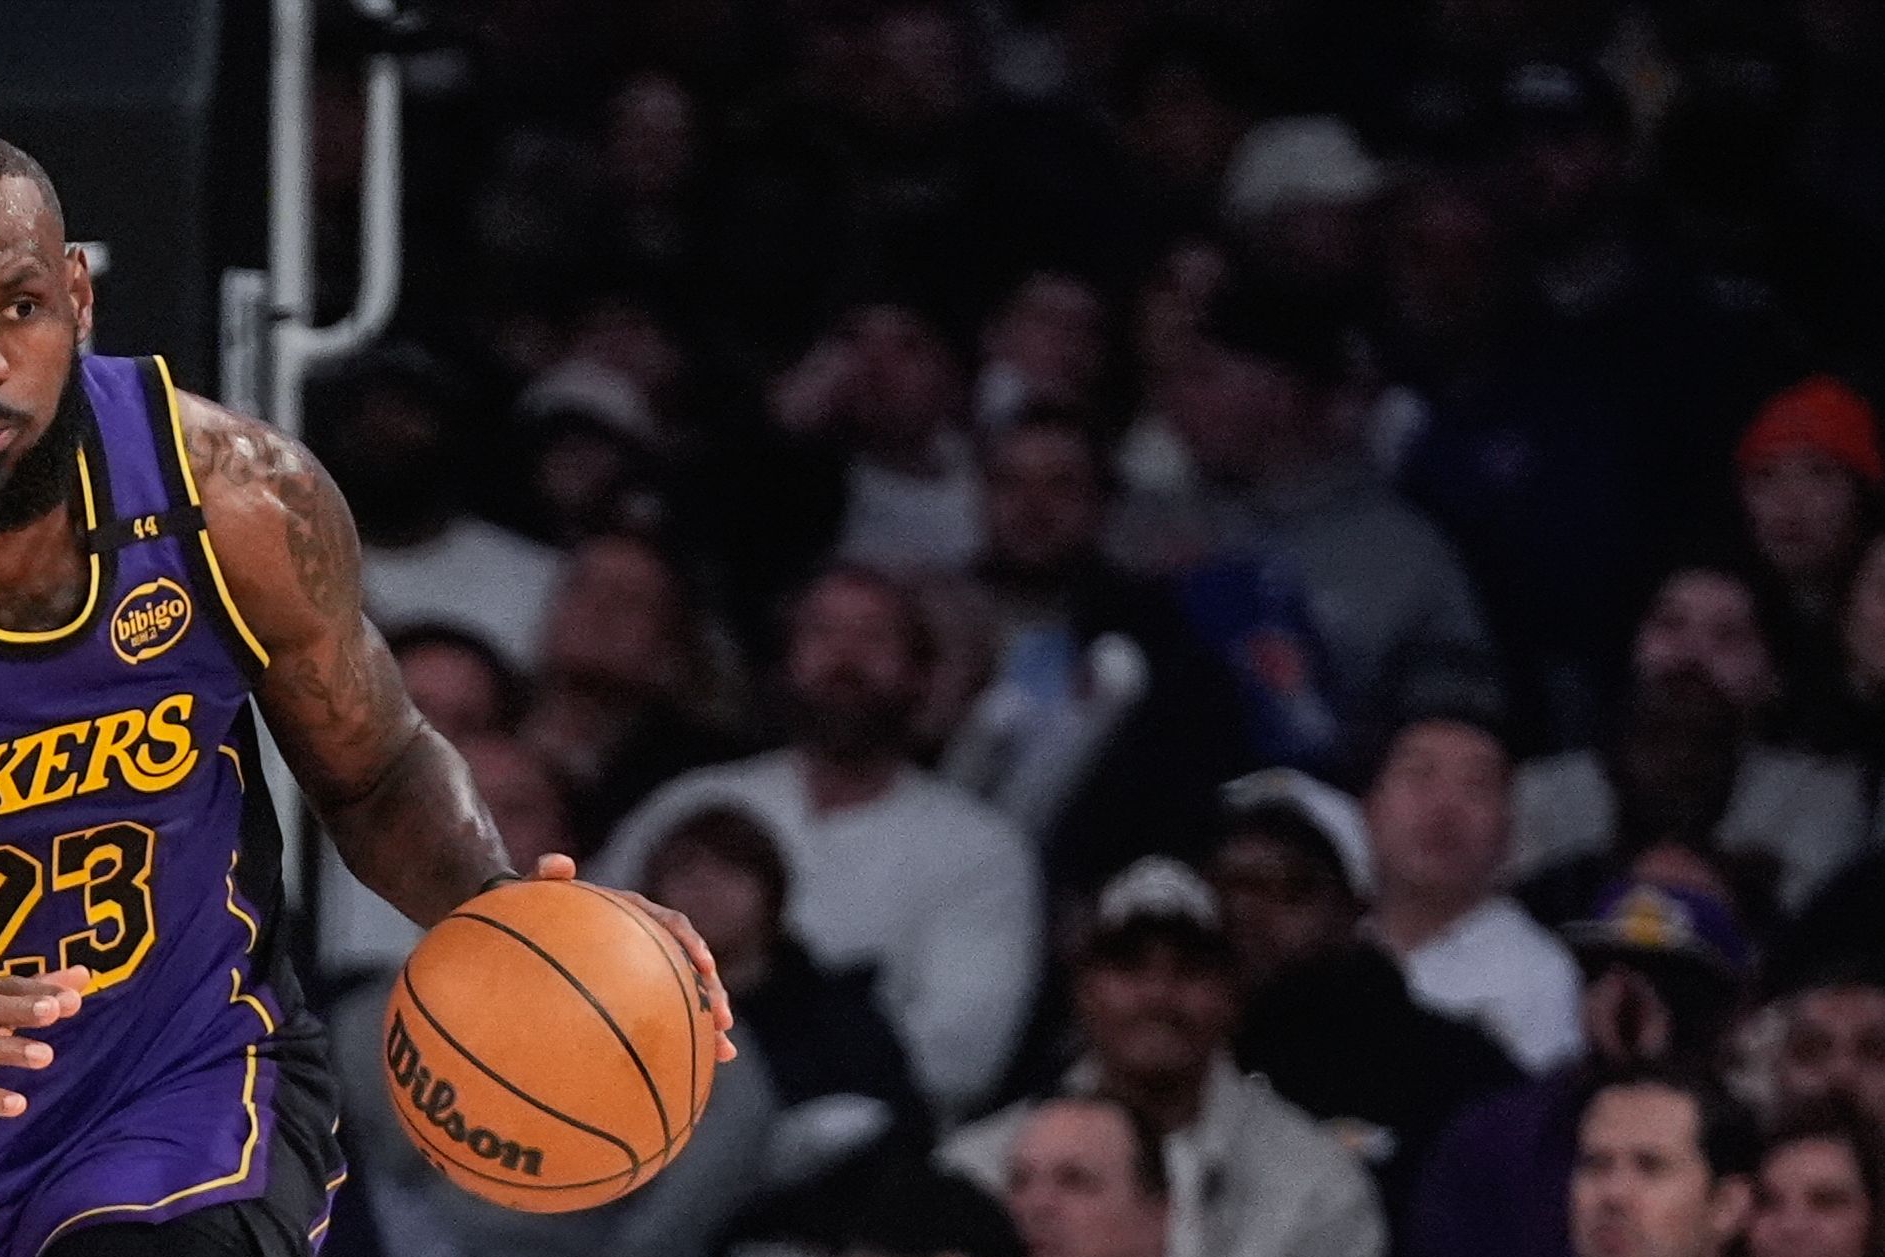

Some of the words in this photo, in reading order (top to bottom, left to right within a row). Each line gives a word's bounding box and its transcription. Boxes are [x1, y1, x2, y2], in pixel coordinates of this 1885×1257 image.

[133, 515, 159, 540] 44
[116, 599, 185, 641] bibigo
[387, 1008, 545, 1177] Wilson
